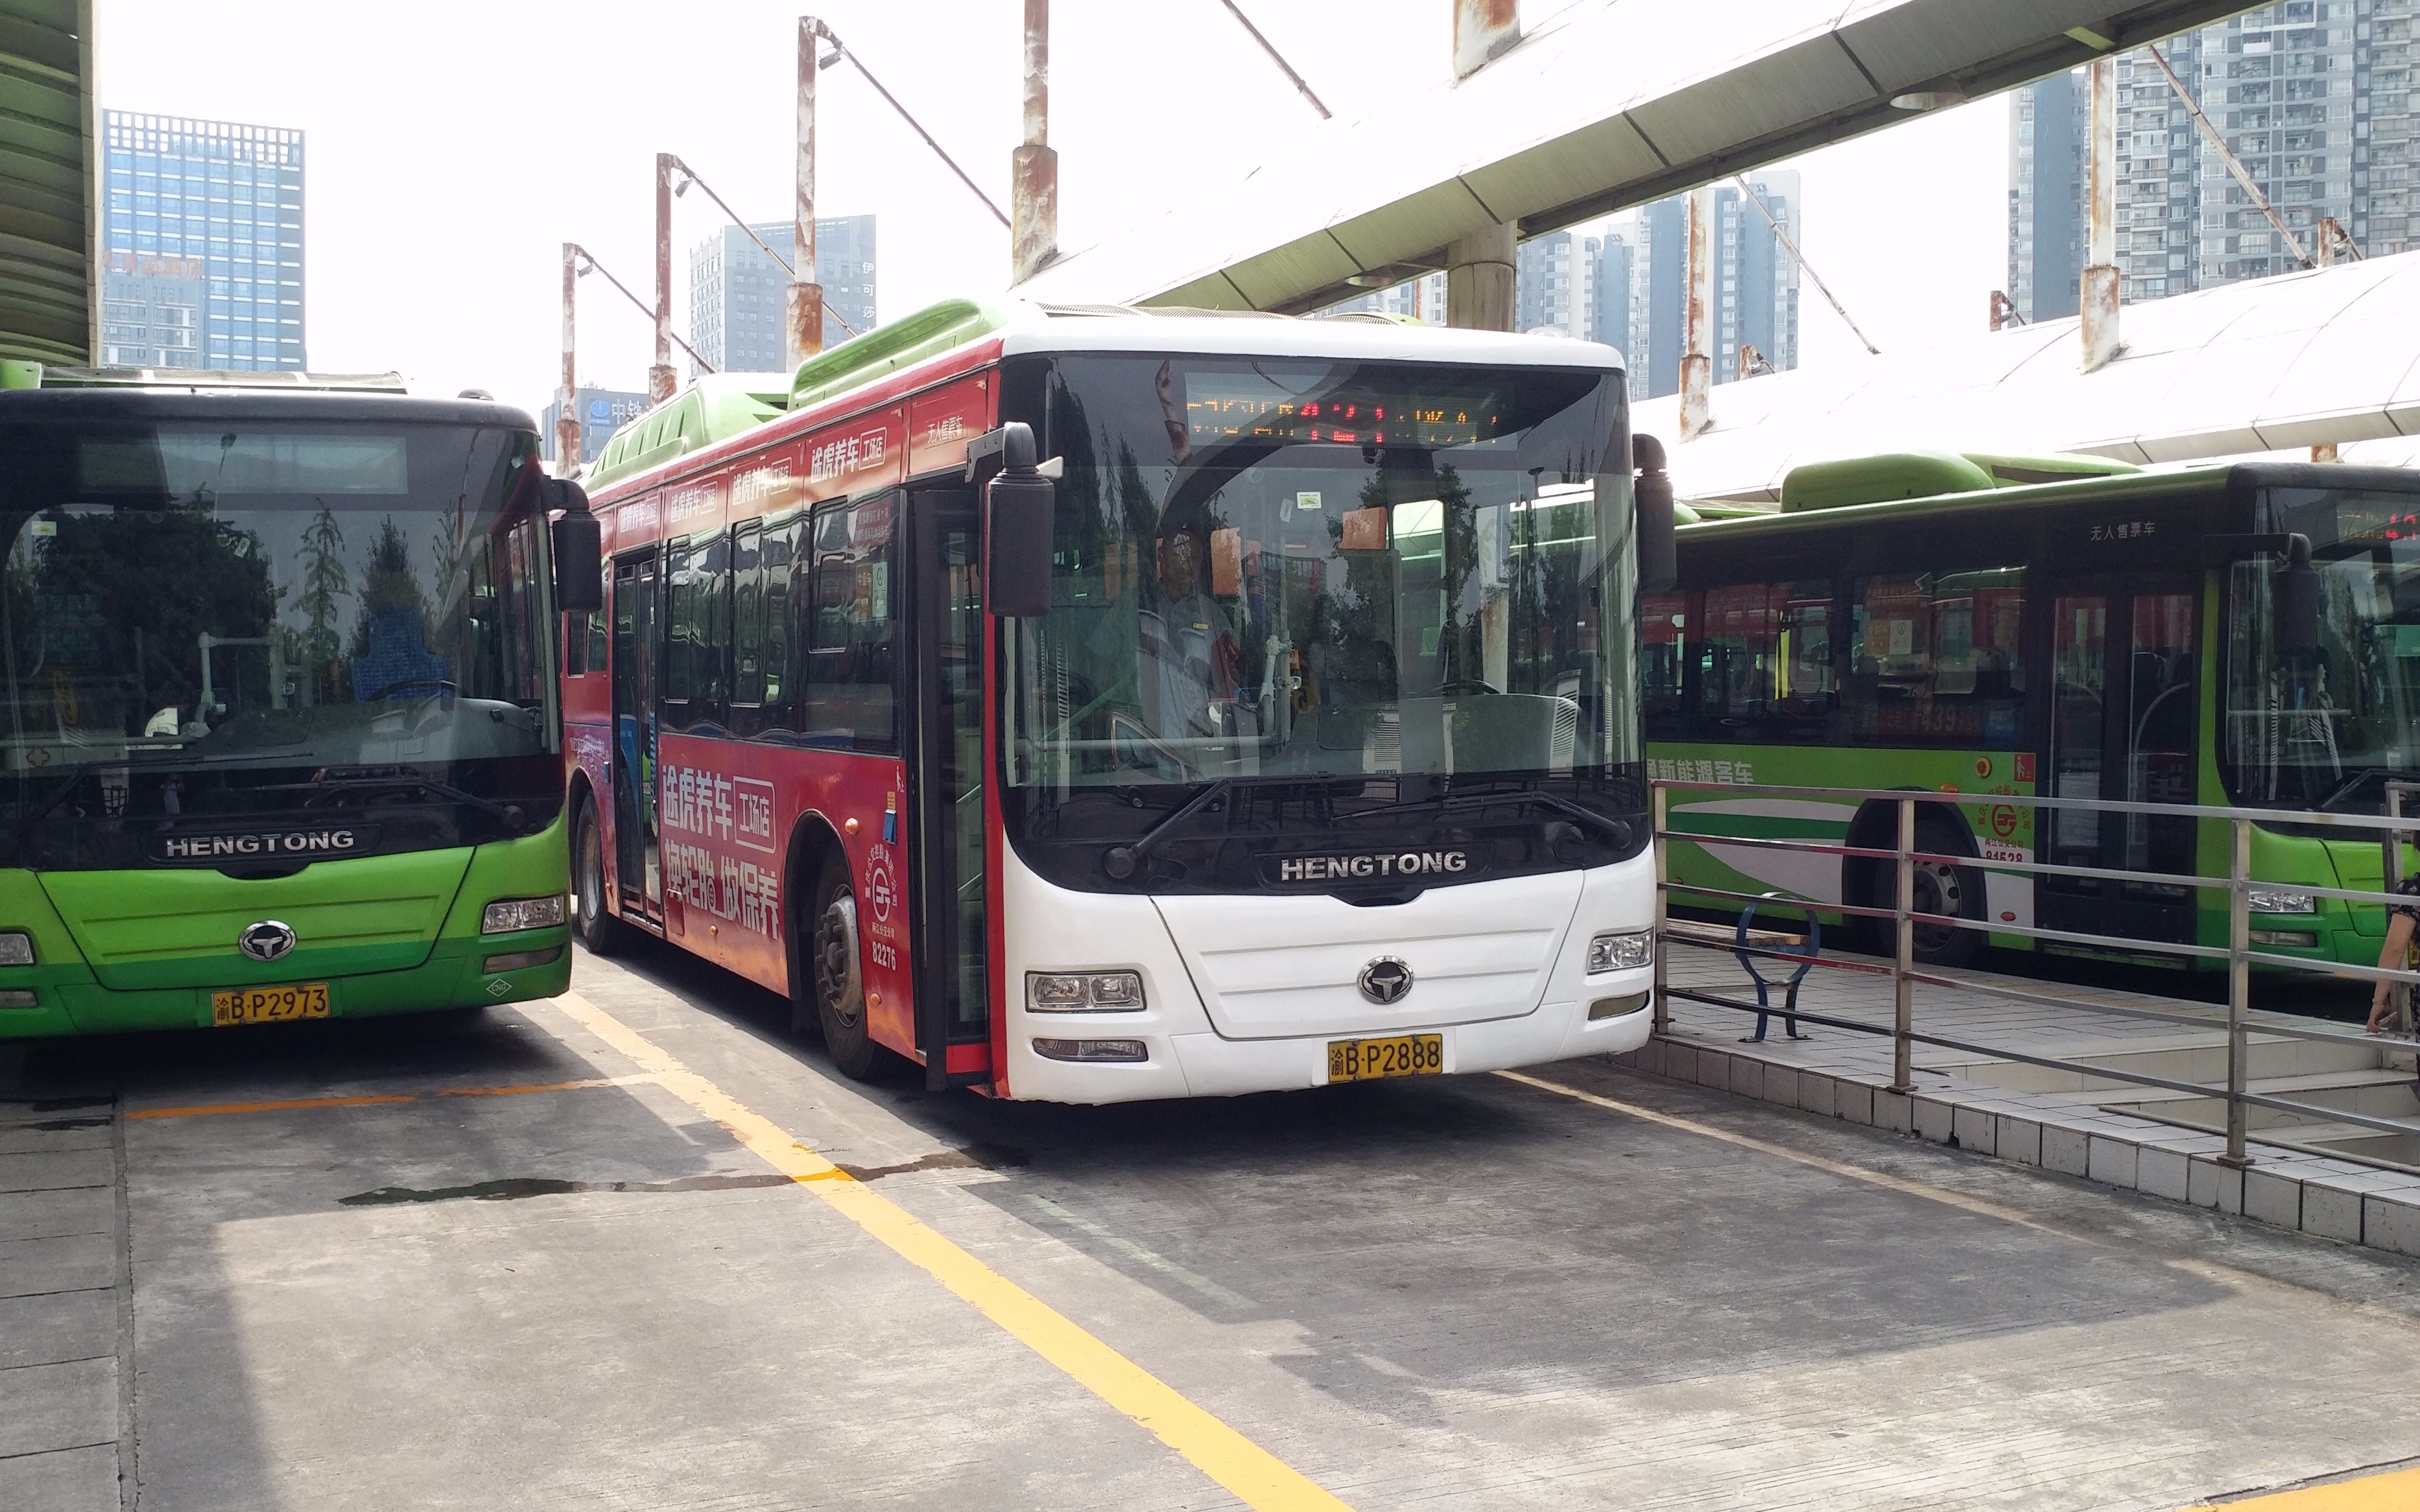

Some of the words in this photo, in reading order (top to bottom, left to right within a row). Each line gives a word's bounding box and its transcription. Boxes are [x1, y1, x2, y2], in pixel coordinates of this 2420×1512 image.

[611, 399, 649, 425] 中铁
[928, 415, 963, 443] 无人售票车
[811, 436, 860, 484] 途虎养车
[862, 436, 883, 462] 工场店
[732, 465, 771, 506] 途虎养车
[2091, 521, 2155, 541] 无人售票车
[663, 764, 733, 841] 途虎养车
[739, 793, 770, 838] 工场店
[167, 831, 354, 857] HENGTONG
[1985, 838, 2024, 848] 两江公交公司
[1281, 851, 1466, 881] HENGTONG
[665, 838, 717, 911] 换轮胎
[721, 855, 779, 939] 做保养
[872, 921, 895, 939] 两江公交公司
[872, 941, 896, 971] 82276
[492, 984, 506, 992] CNG
